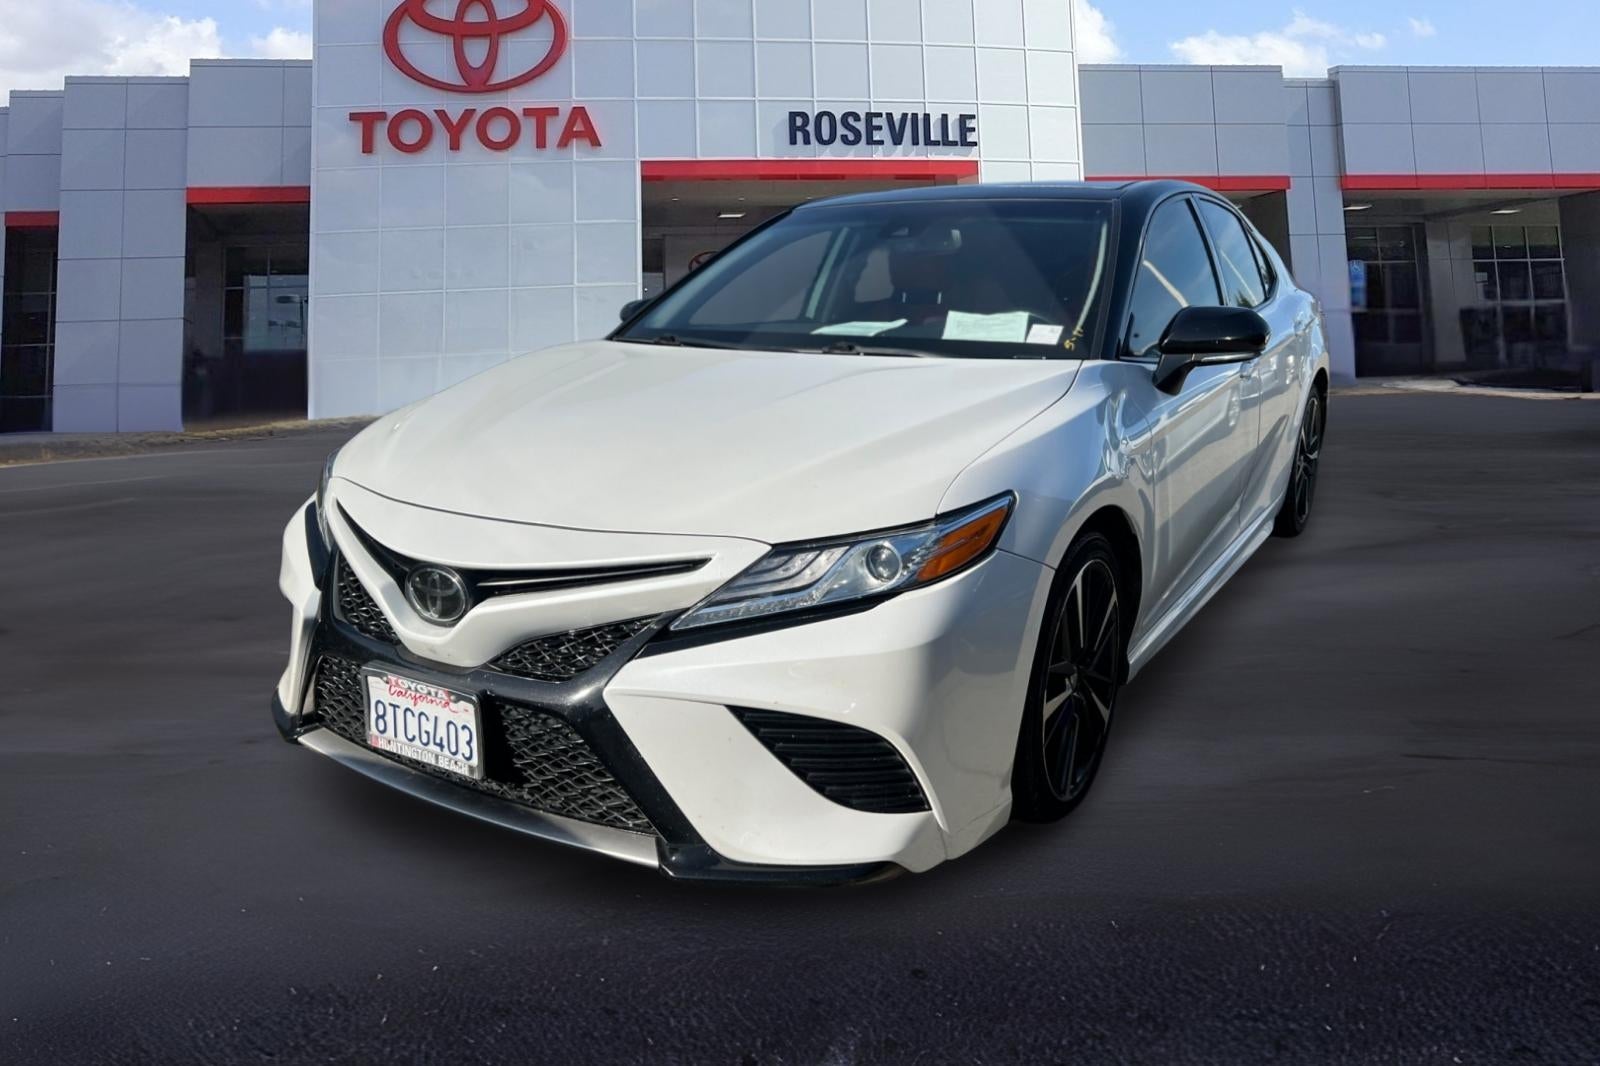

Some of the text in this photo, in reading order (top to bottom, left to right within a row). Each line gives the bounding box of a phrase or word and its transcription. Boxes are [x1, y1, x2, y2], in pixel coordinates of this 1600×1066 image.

[349, 106, 602, 154] TOYOTA
[788, 111, 978, 147] ROSEVILLE
[388, 675, 450, 700] TOYOTA
[375, 699, 473, 761] 8TCG403
[378, 738, 468, 773] HUNTINGTON BEACH
